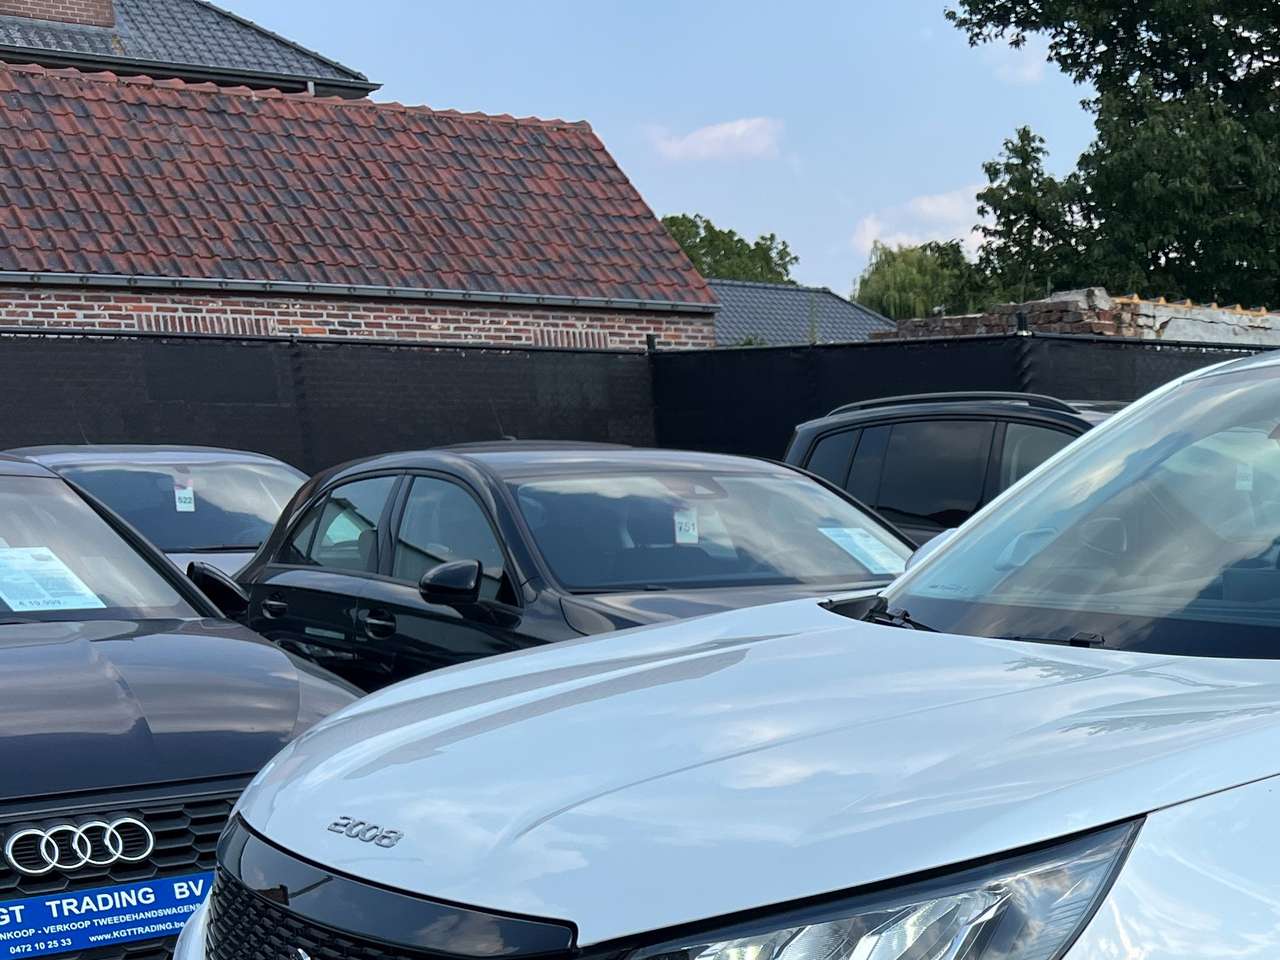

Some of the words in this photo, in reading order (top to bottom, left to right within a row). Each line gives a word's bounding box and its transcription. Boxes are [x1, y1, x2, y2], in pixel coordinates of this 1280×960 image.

[326, 815, 404, 849] 2008
[0, 904, 25, 926] GT
[45, 887, 155, 918] TRADING
[173, 879, 204, 900] BV
[0, 928, 36, 941] NKOOP
[43, 920, 91, 934] VERKOOP
[9, 943, 33, 954] 0472
[34, 941, 46, 951] 10
[47, 939, 60, 949] 25
[60, 938, 73, 947] 33
